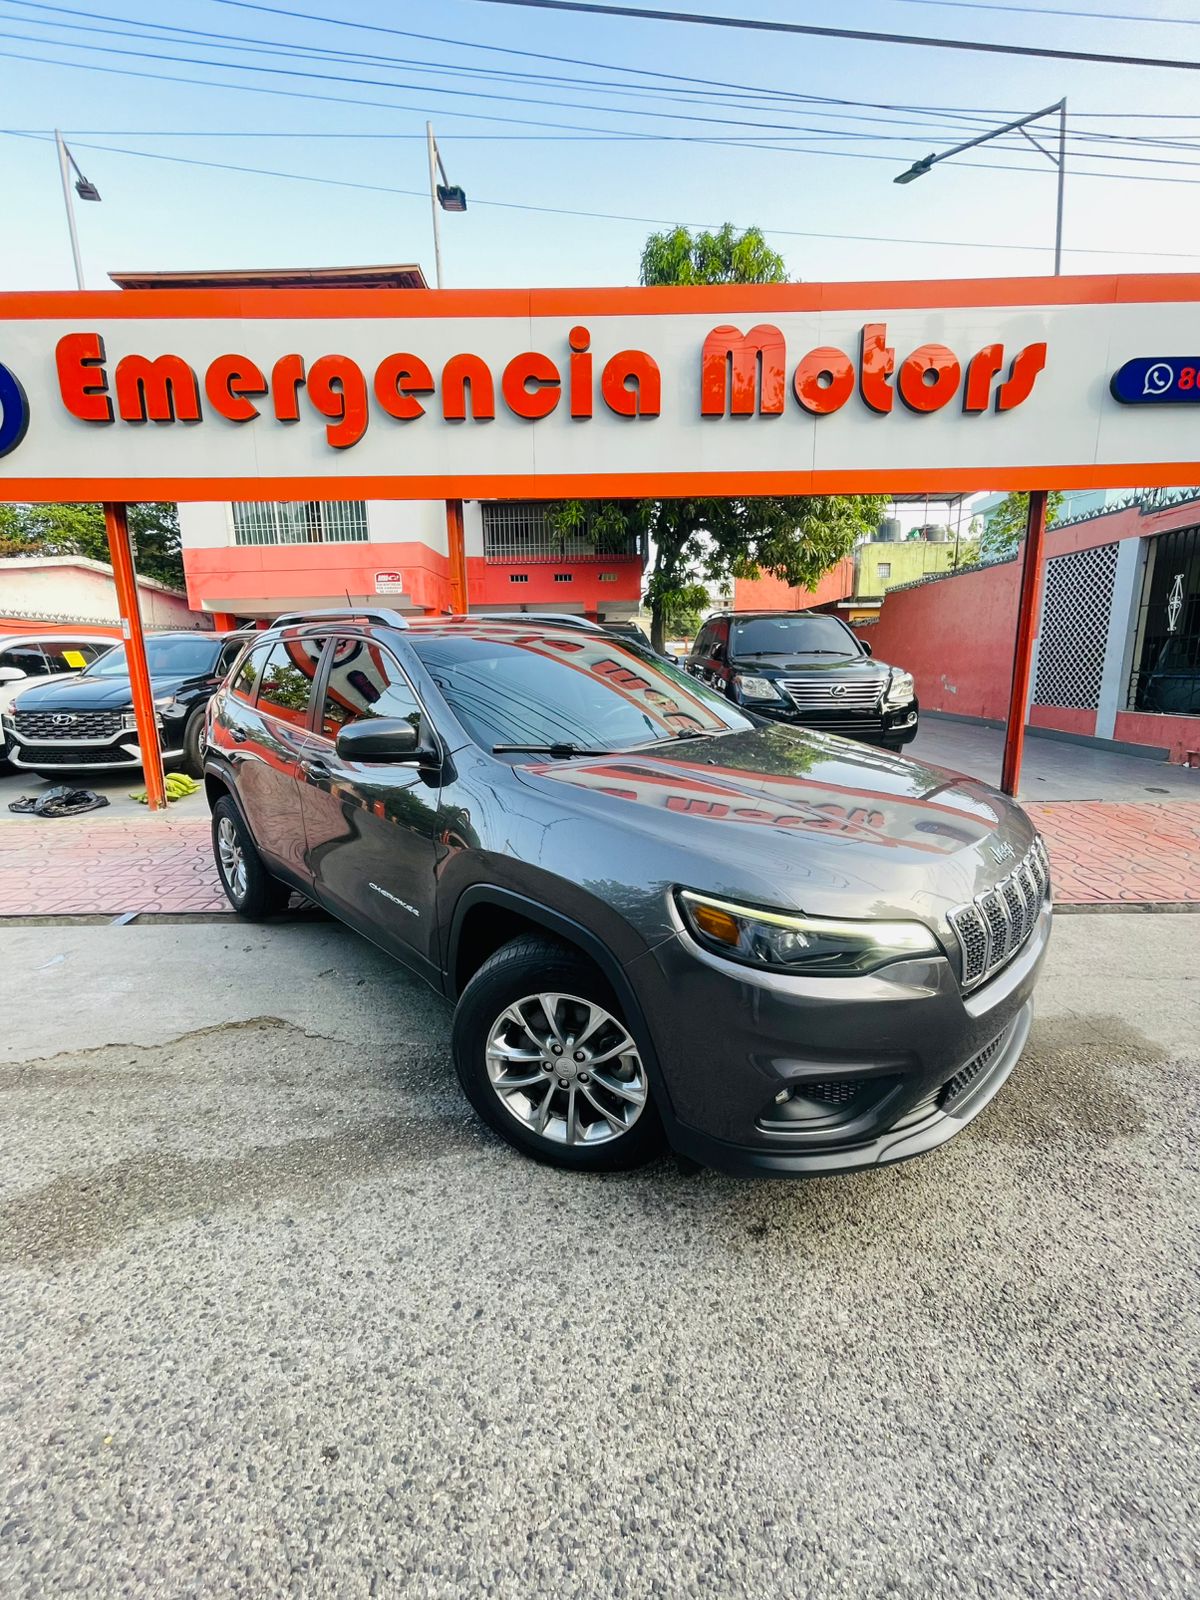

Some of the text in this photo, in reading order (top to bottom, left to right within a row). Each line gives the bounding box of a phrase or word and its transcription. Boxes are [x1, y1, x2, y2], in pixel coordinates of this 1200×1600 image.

[55, 323, 1047, 449] Emergencia Motors
[989, 841, 1016, 865] Jeep
[368, 882, 420, 917] CHEROKEE
